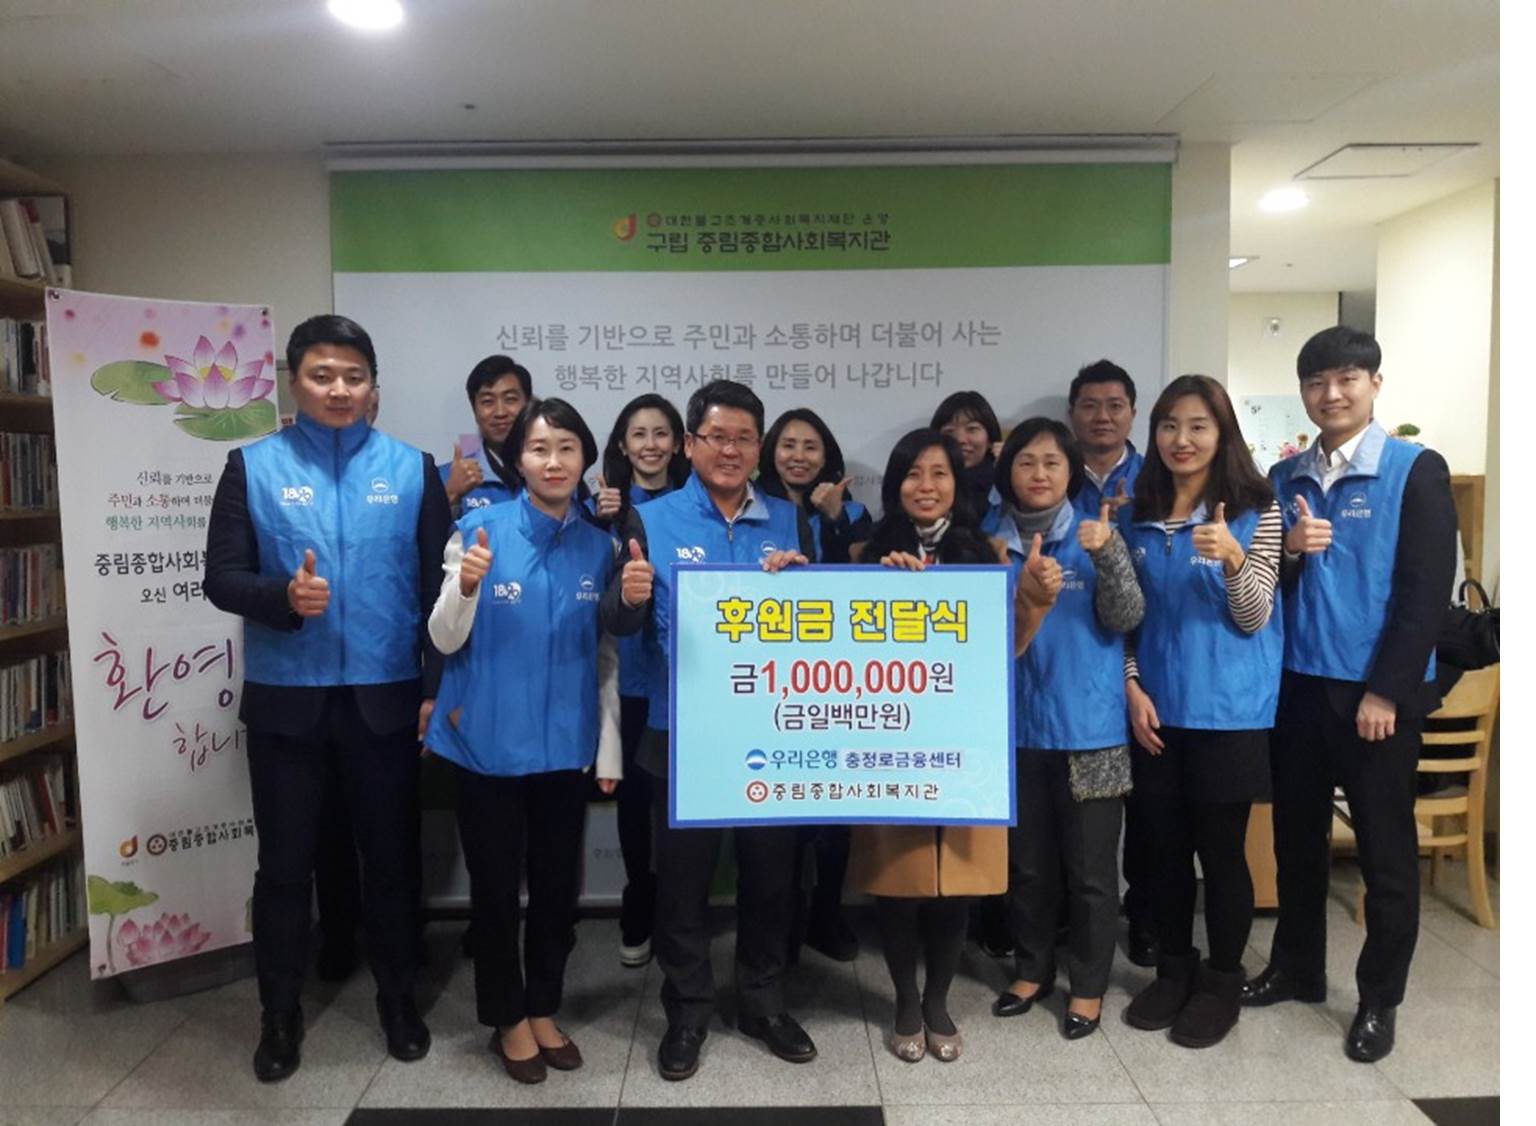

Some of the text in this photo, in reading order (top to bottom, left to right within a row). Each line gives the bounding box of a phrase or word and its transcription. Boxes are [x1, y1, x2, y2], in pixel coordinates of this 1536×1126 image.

[647, 230, 891, 253] 구립 중림종합사회복지관
[496, 320, 1002, 351] 신뢰를 기반으로 주민과 소통하며 더불어 사는
[554, 364, 627, 391] 행복한
[766, 362, 836, 390] 만들어
[847, 361, 944, 388] 나갑니다
[137, 470, 172, 486] 신뢰를
[141, 587, 166, 603] 오신
[715, 596, 968, 643] 후원금 전달식
[93, 631, 235, 721] 환영
[730, 659, 954, 700] 금1,000,000원
[773, 702, 911, 732] (금일백만원)
[770, 749, 962, 769] 우리은행 충정로금융센터
[772, 783, 939, 800] 중림종합사회복지관
